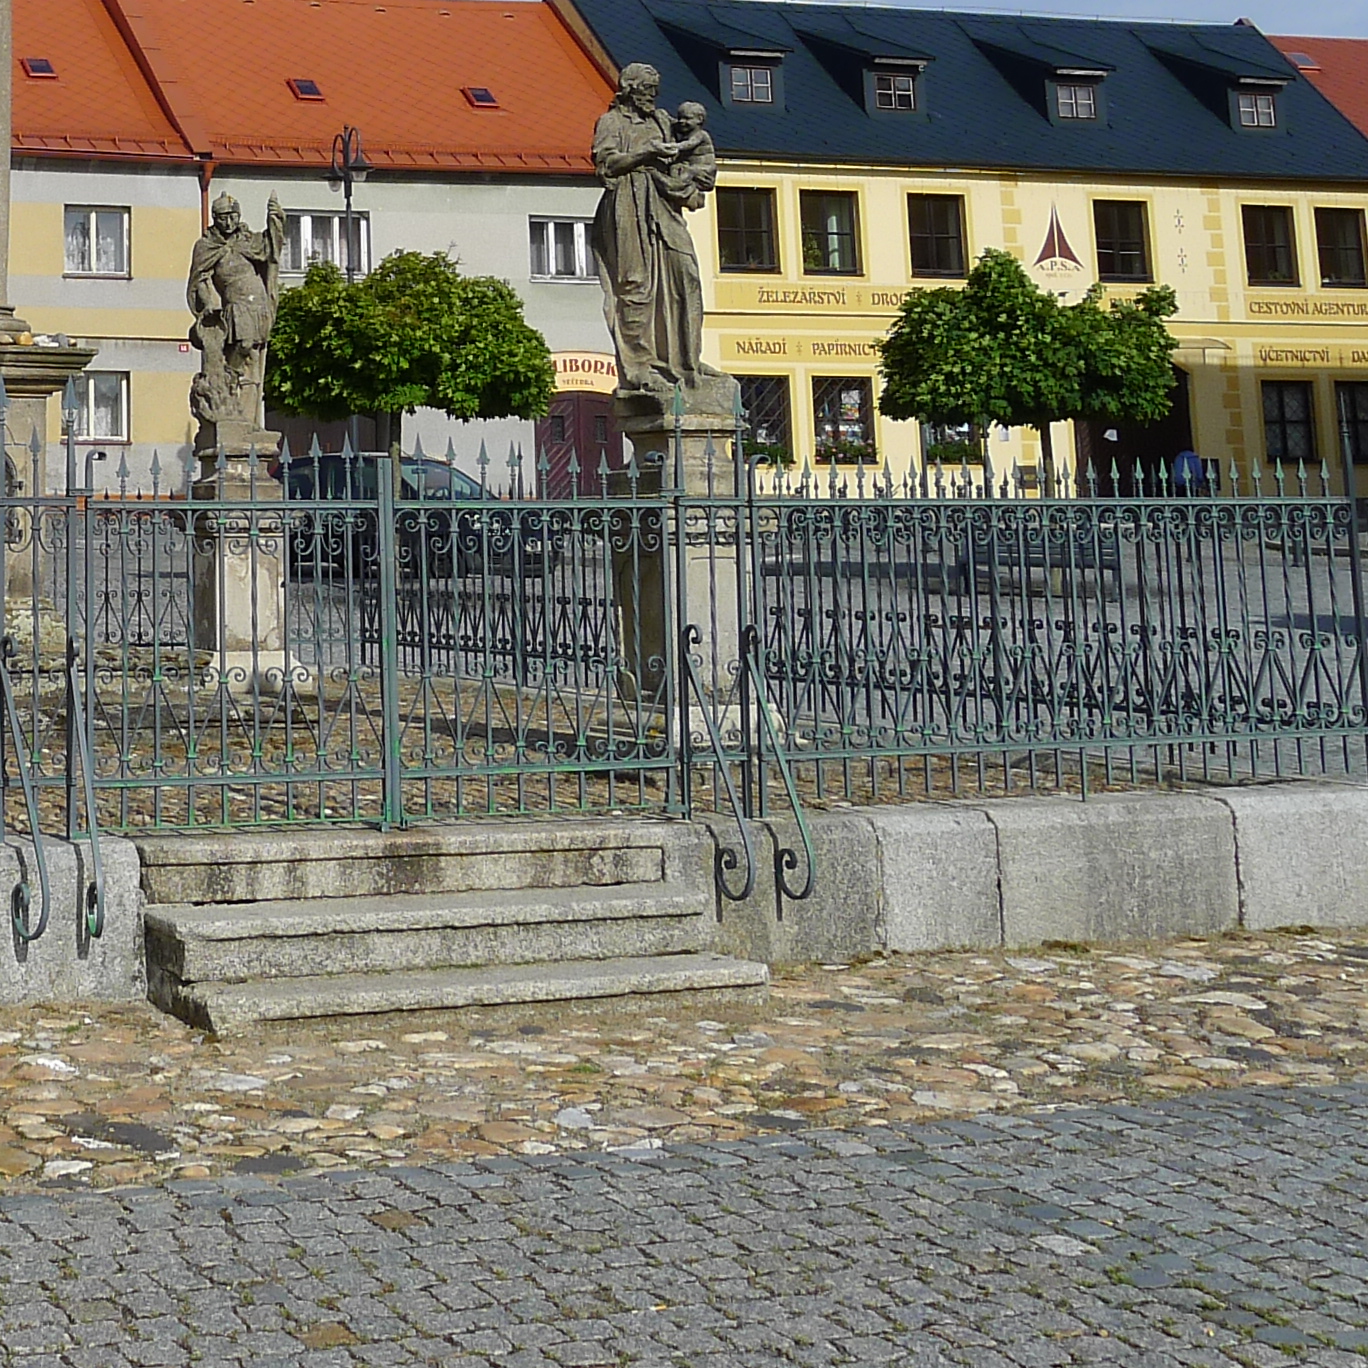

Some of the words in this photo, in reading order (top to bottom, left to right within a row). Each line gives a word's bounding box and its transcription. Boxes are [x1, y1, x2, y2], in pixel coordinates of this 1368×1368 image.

[758, 286, 846, 305] ŽELEZÁŘSTVÍ
[1249, 298, 1310, 315] CESTOVNÍ
[736, 337, 787, 355] NÁŘADÍ
[1259, 345, 1330, 363] ÚČETNICTVÍ
